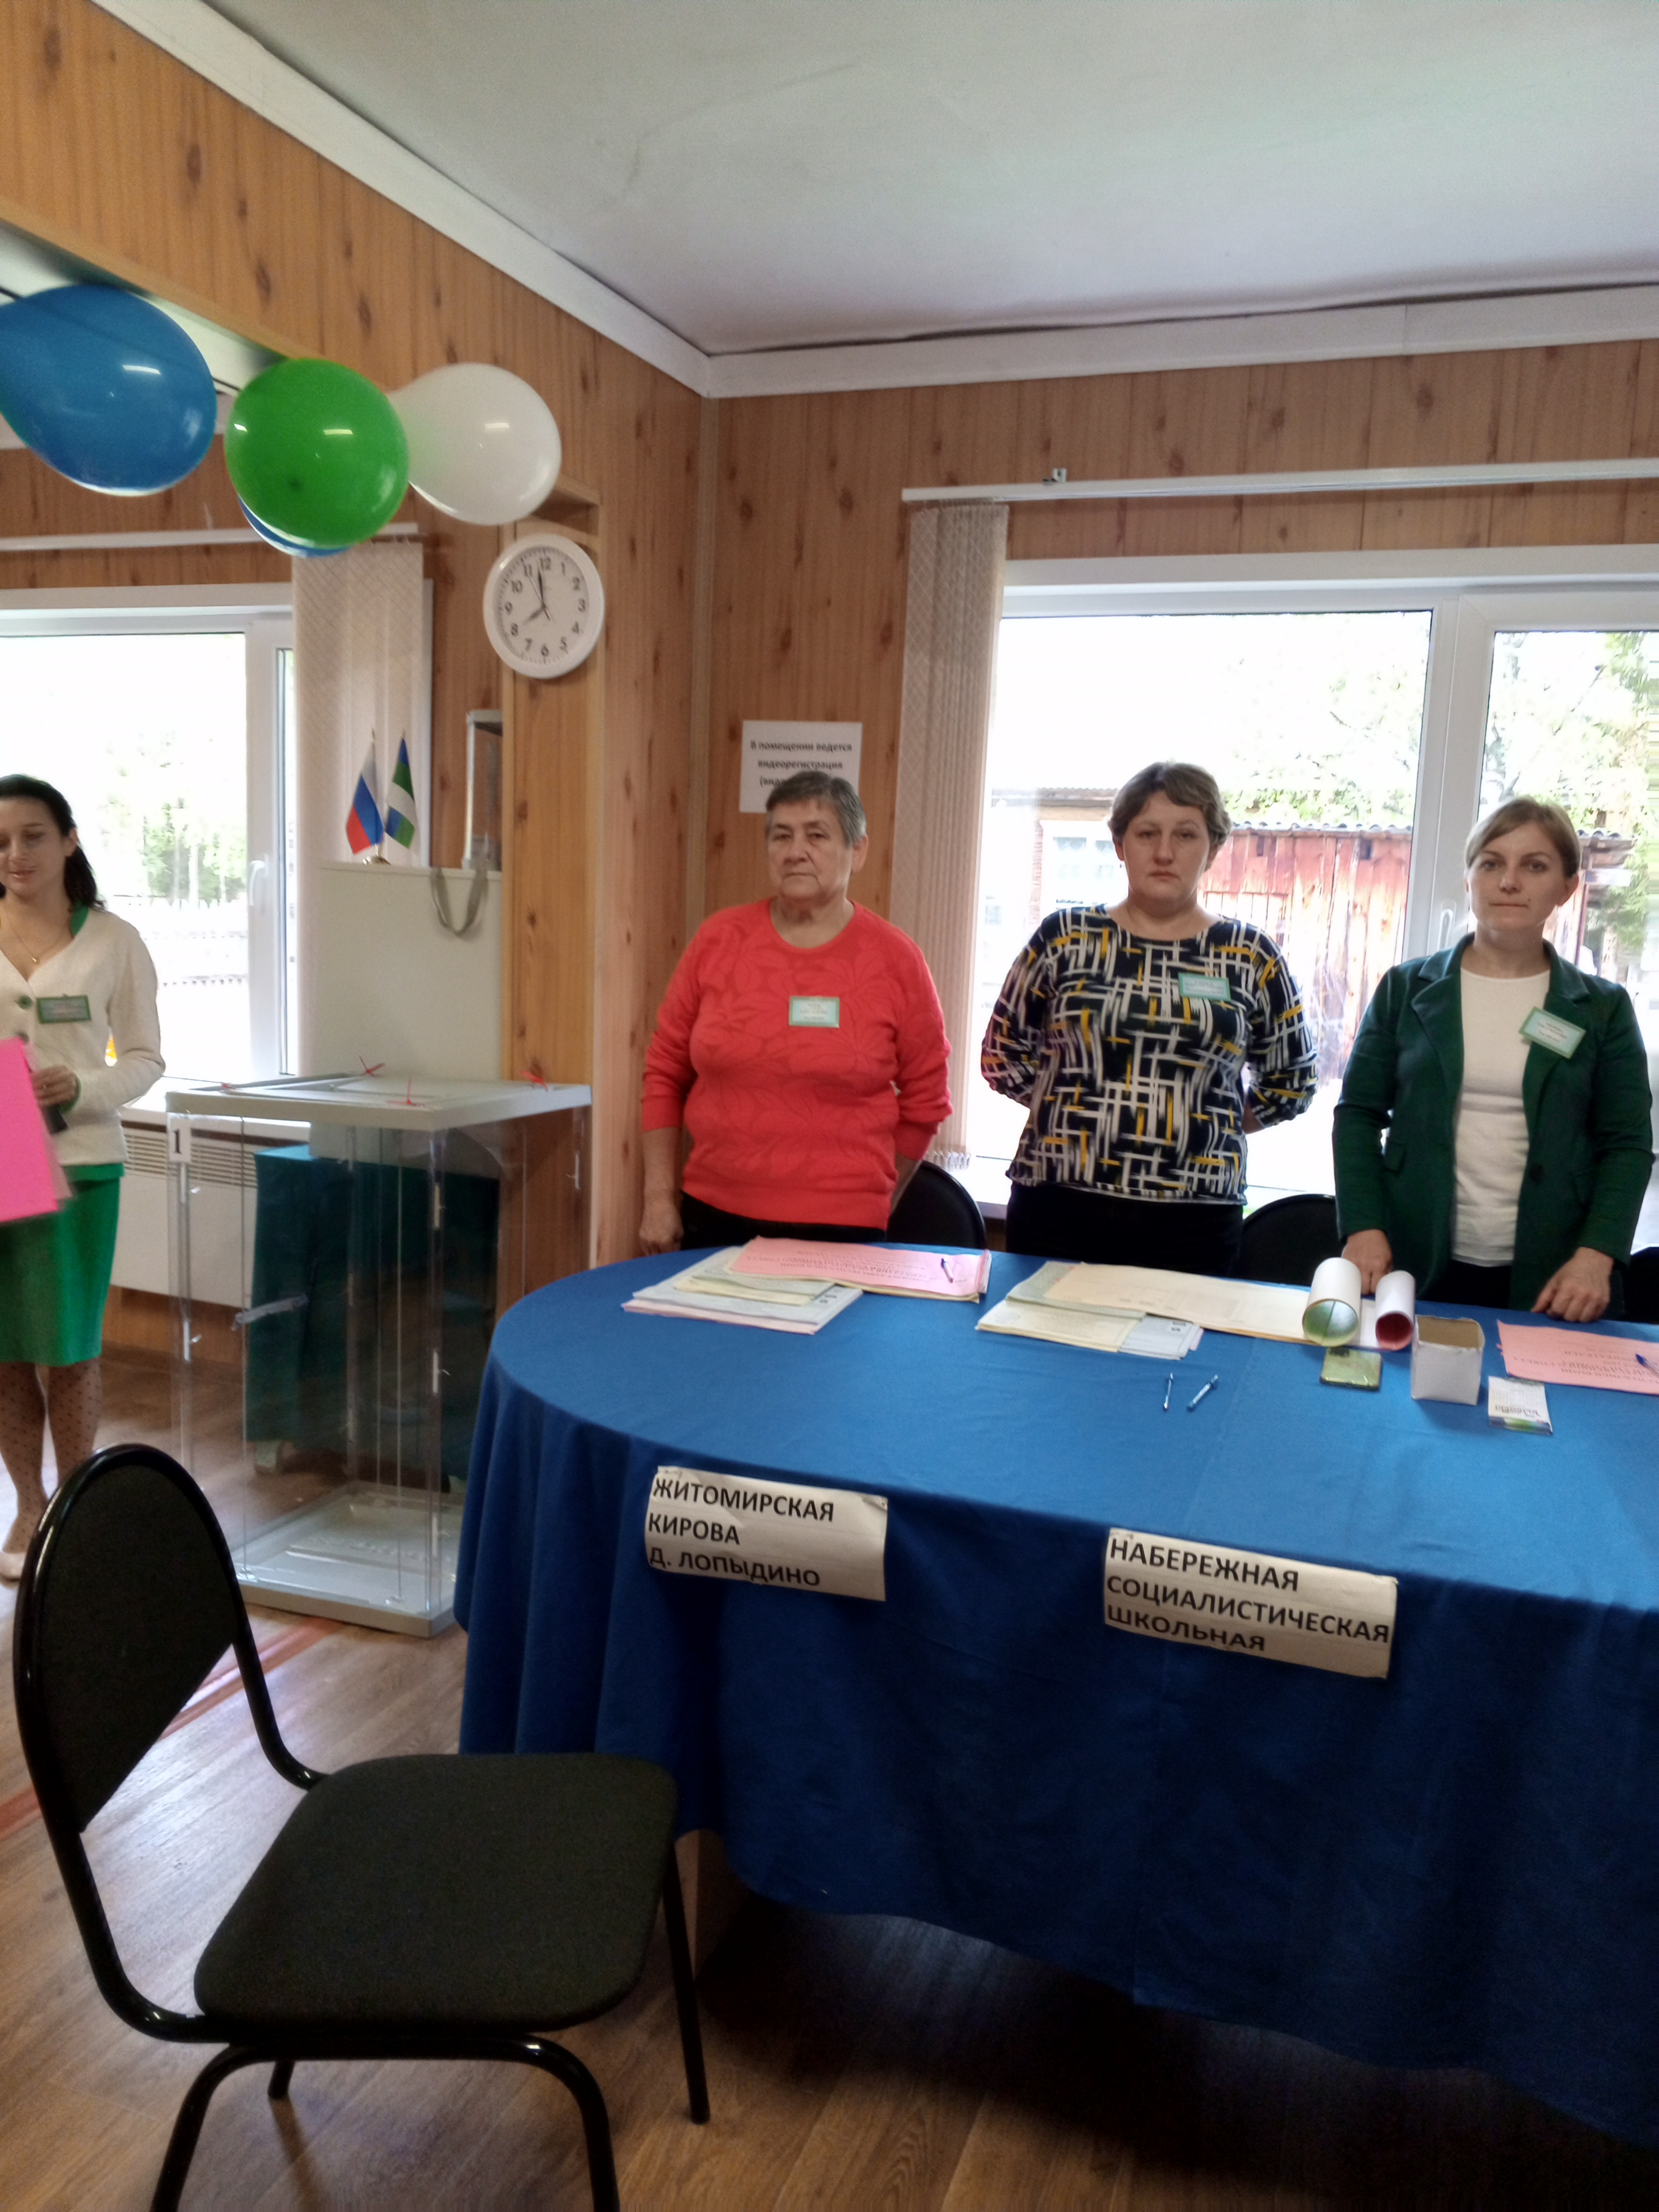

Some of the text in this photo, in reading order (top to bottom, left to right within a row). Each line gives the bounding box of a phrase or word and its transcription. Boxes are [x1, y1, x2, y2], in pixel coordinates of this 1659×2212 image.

[173, 1128, 182, 1154] 1
[653, 1478, 834, 1522] ЖИТОМИРСКАЯ
[648, 1513, 740, 1545] КИРОВА
[650, 1547, 820, 1587] Д. ЛОПЫДИНО
[1110, 1538, 1299, 1592] НАБЕРЕЖНАЯ
[1107, 1576, 1390, 1644] СОЦИАЛИСТИЧЕСКАЯ
[1107, 1603, 1265, 1652] ШКОЛЬНАЯ
